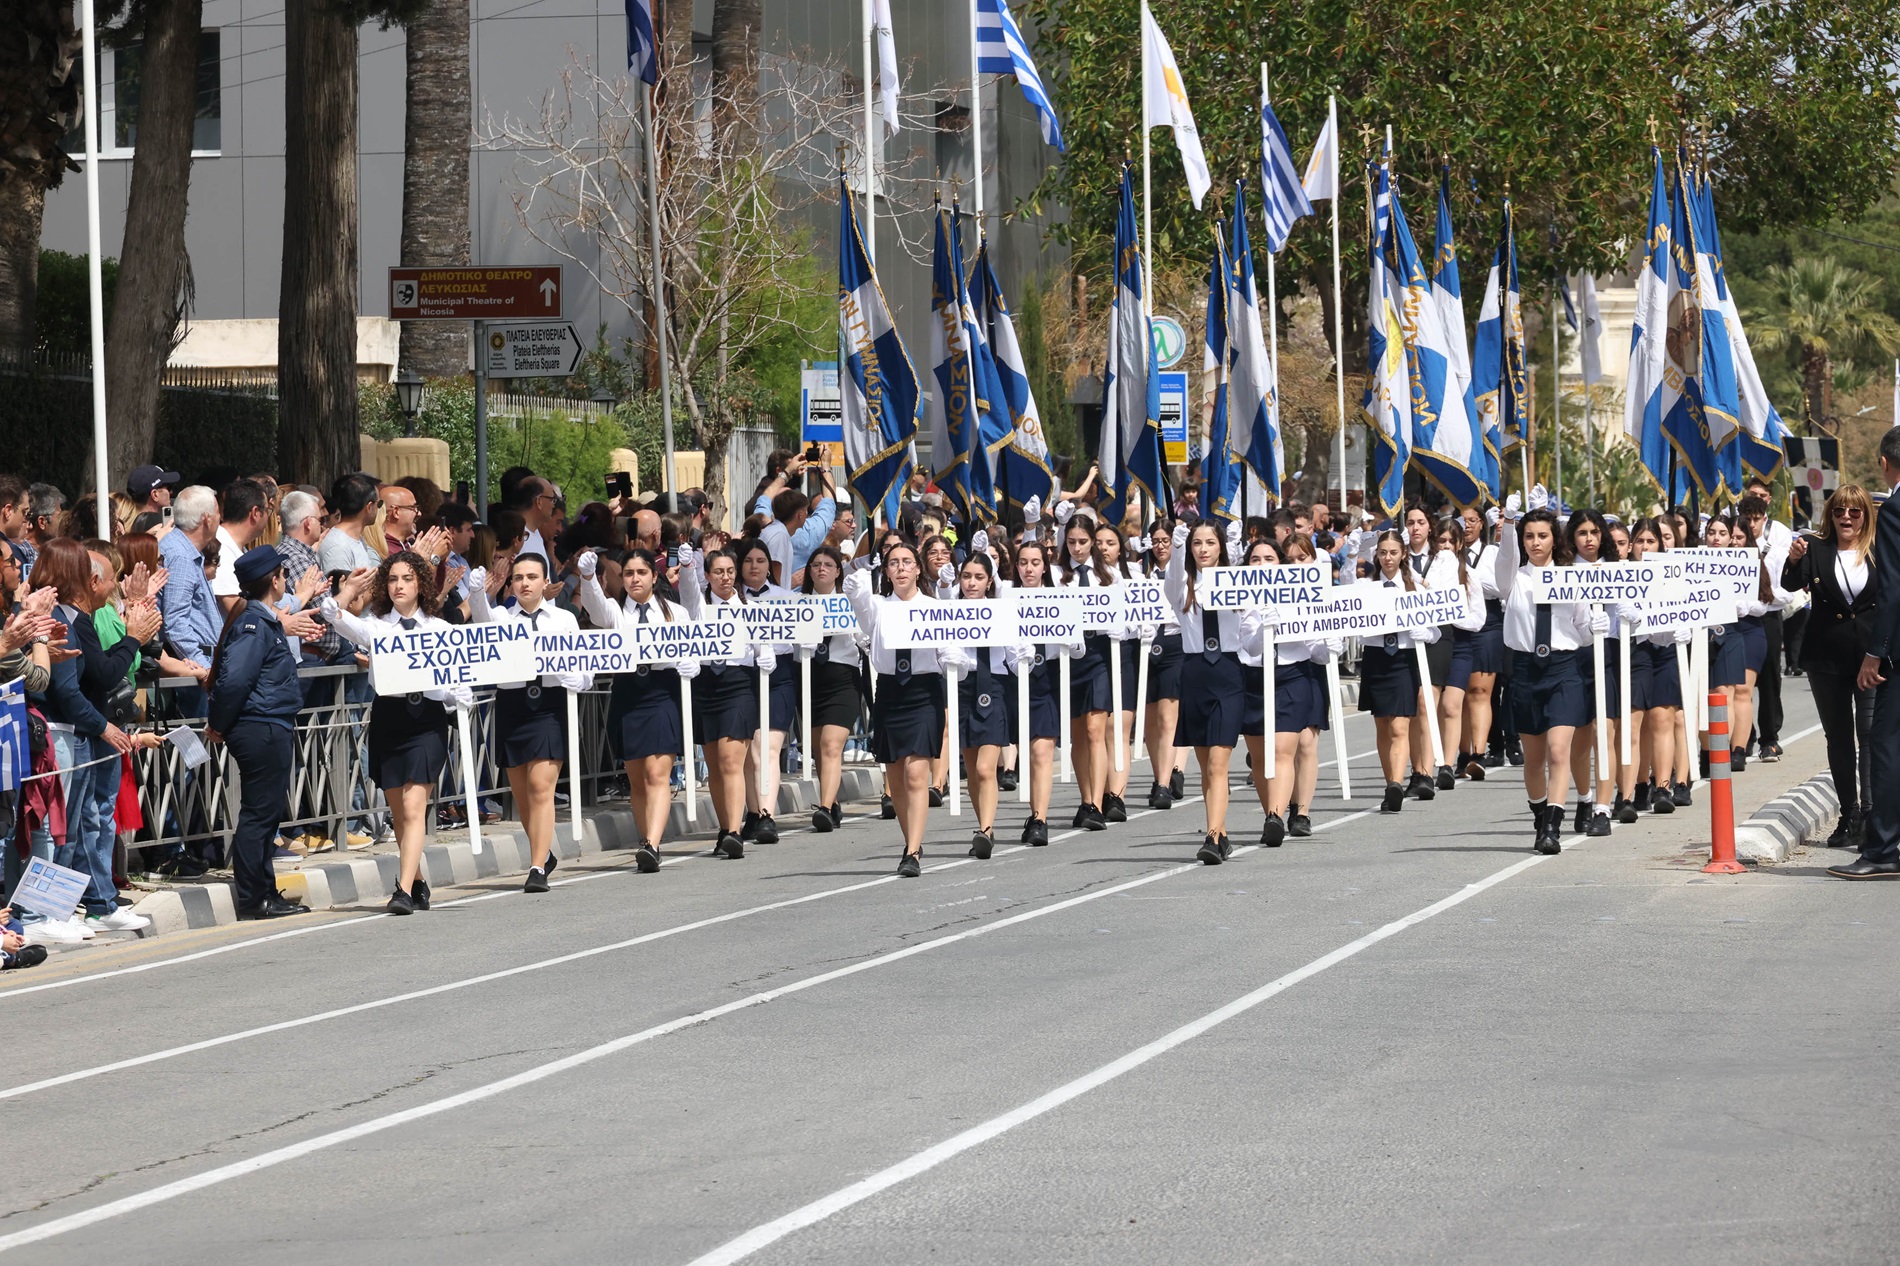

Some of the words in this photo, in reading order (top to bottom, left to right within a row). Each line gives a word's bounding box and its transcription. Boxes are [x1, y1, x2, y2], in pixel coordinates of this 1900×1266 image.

[420, 271, 482, 281] ΔΗΜΟΤΙΚΟ
[486, 270, 532, 280] ΘΕΑΤΡΟ
[420, 283, 487, 294] ΛΕΥΚΩΣΙΑΣ
[420, 297, 464, 306] Municipal
[467, 297, 502, 305] Theatre
[505, 296, 514, 304] of
[420, 308, 454, 316] Nicosia
[506, 330, 530, 342] ΠΛΑΤΕΙΑ
[531, 328, 566, 341] ΕΛΕΥΘΕΡΙΑΣ
[513, 345, 531, 357] Plateia
[532, 344, 560, 356] Eleftherias
[514, 359, 539, 370] Eleftheria
[541, 358, 560, 371] Square
[932, 283, 968, 435] ΥΜΝΑΣΙΟΝ
[1565, 569, 1654, 583] ΓΥΜΝΑΣΙΟ
[1663, 565, 1681, 578] ΣΙΟ
[1685, 562, 1705, 574] ΚΗ
[1709, 563, 1757, 577] ΣΧΟΛΗ
[1214, 567, 1320, 587] ΓΥΜΝΑΣΙΟ
[1210, 587, 1323, 606] ΚΕΡΥΝΕΙΑΣ
[1547, 586, 1649, 600] ΑΜ/ΧΩΣΤΟΥ
[909, 607, 992, 622] ΓΥΜΝΑΣΙΟ
[1017, 606, 1060, 618] ΝΑΣΙΟ
[1396, 605, 1466, 628] ΑΛΟΥΣΗΣ
[1647, 608, 1709, 627] ΜΟΡΦΟΥ
[823, 615, 857, 628] ΣΤΟΥ
[1313, 613, 1387, 632] ΑΜΒΡΟΣΙΟΥ
[636, 622, 735, 643] ΓΥΜΝΑΣΙΟ
[746, 626, 796, 640] ΥΣΗΣ
[911, 627, 992, 641] ΛΑΠΗΘΟΥ
[1019, 624, 1075, 637] ΝΟΙΚΟΥ
[373, 623, 529, 655] ΚΑΤΕΧΟΜΕΝΑ
[534, 633, 623, 652] ΥΜΝΑΣΙΟ
[407, 644, 501, 670] ΣΧΟΛΕΙΑ
[639, 640, 733, 660] ΚΥΘΡΑΙΑΣ
[535, 653, 632, 673] ΟΚΑΡΠΑΣΟΥ
[433, 666, 477, 686] Μ.Ε.
